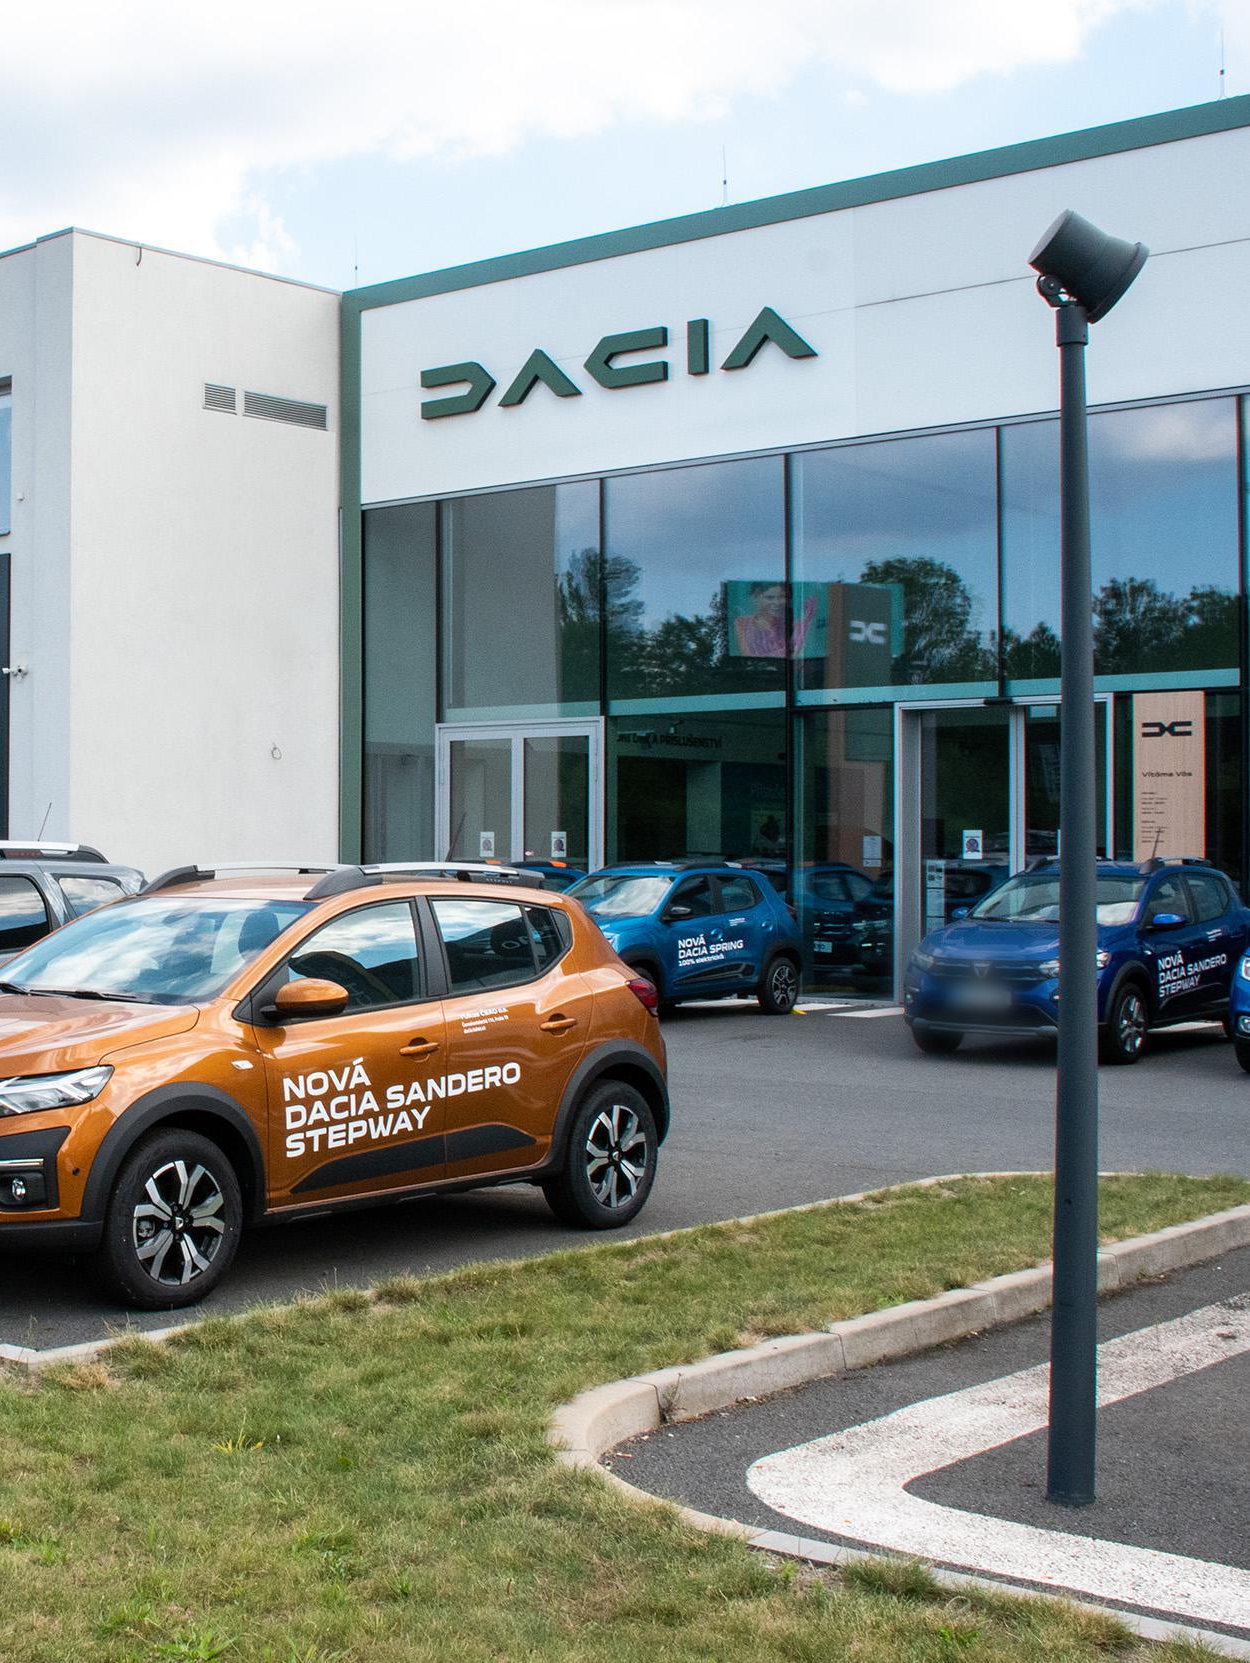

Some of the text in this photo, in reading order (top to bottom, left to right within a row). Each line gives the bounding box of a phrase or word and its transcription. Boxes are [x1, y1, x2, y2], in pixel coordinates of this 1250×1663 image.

[420, 305, 819, 420] DACIA
[678, 933, 706, 949] NOVÁ
[678, 940, 744, 959] DACIA SPRING
[1158, 950, 1184, 971] NOVÁ
[1159, 953, 1227, 984] DACIA SANDERO
[1159, 975, 1201, 998] STEPWAY
[283, 1057, 371, 1101] NOVÁ
[285, 1062, 521, 1130] DACIA SANDERO
[285, 1106, 431, 1158] STEPWAY
